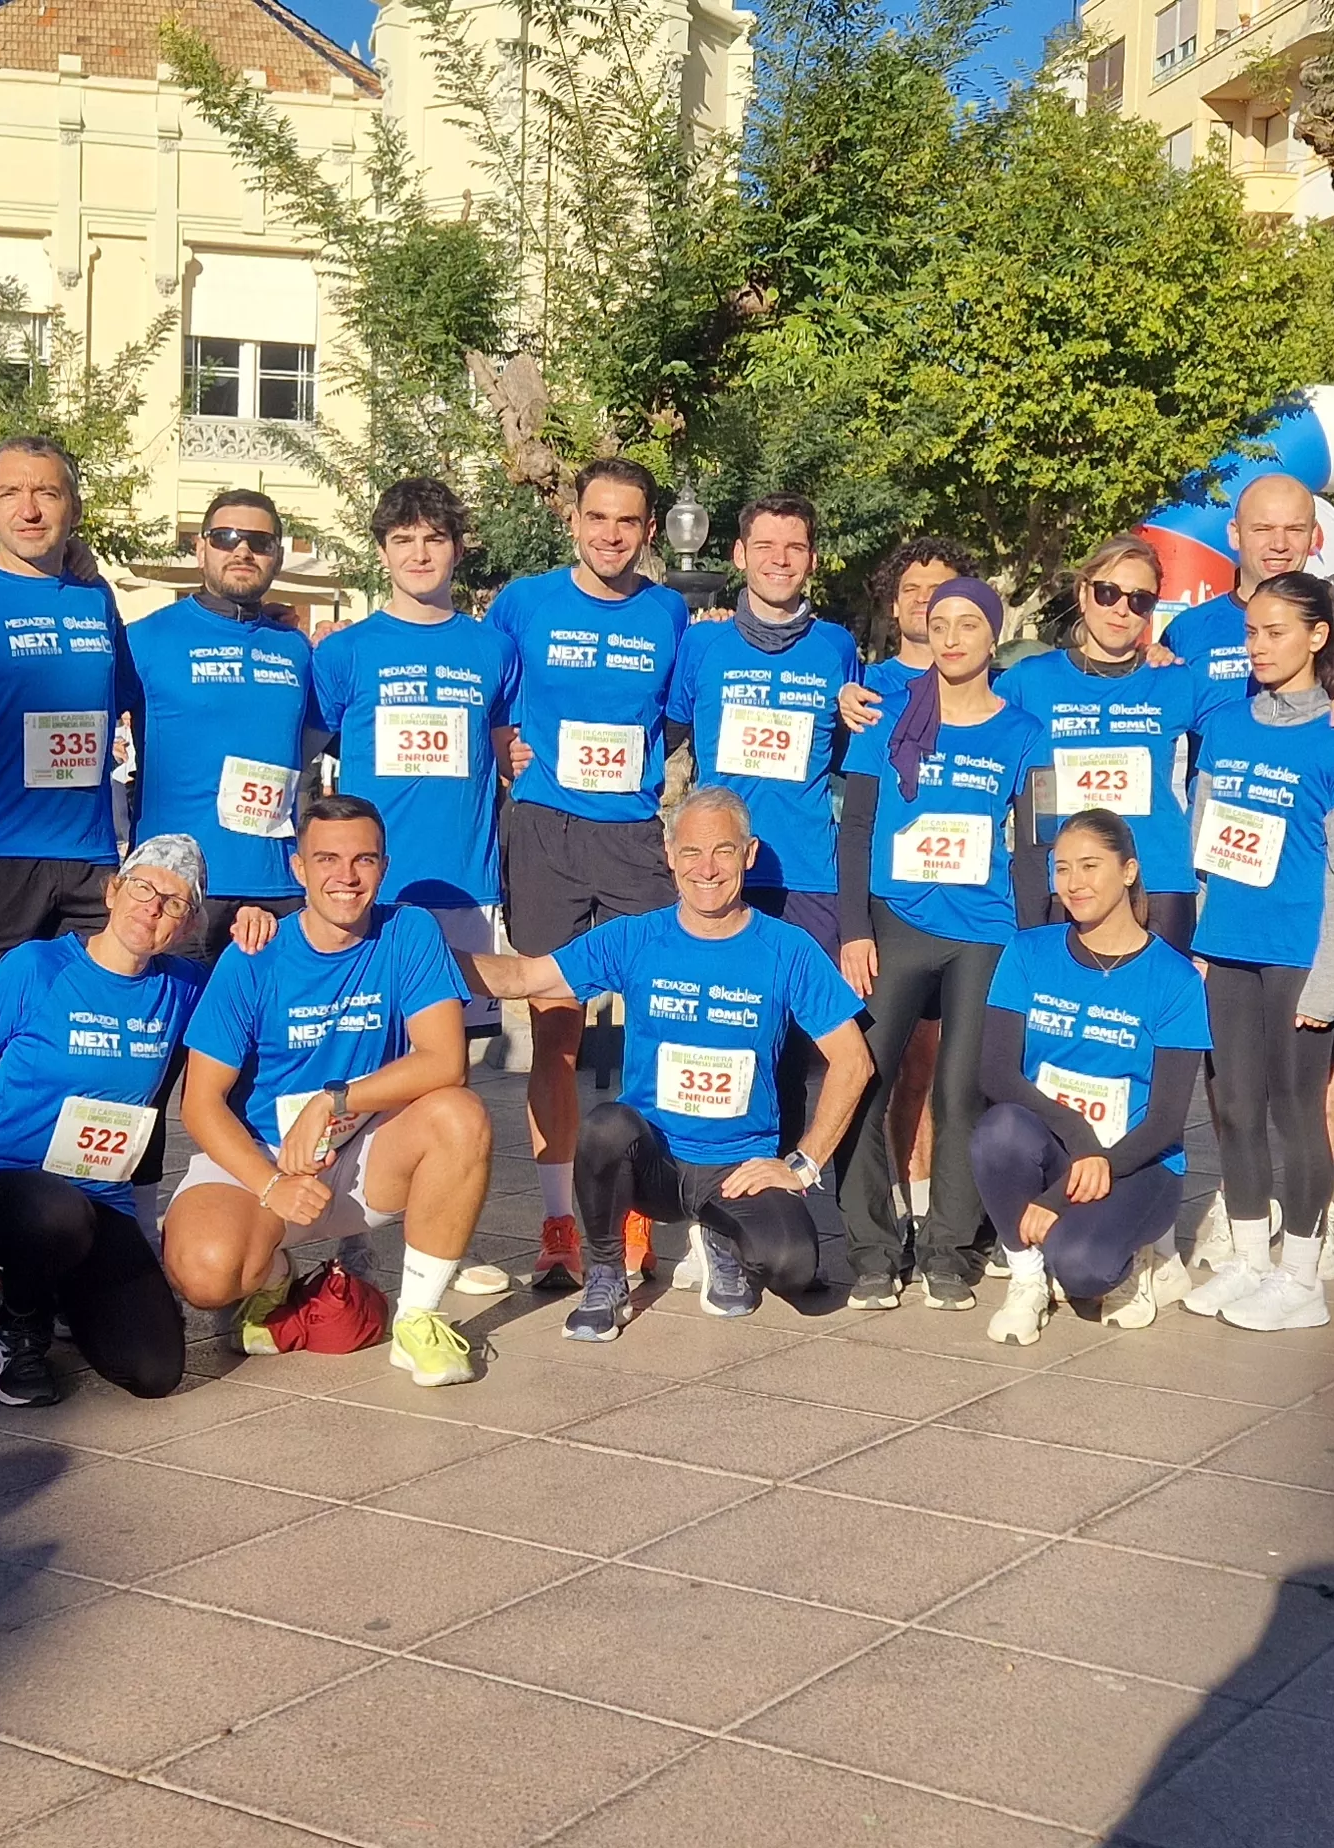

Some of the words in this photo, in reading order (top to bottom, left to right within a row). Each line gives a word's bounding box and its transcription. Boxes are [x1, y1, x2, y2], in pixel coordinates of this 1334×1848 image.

[5, 617, 55, 629] MEDIAZION
[9, 633, 59, 649] NEXT
[69, 638, 102, 648] HOME
[551, 630, 599, 643] MEDIAZION
[619, 634, 656, 652] kablex
[189, 646, 243, 658] MEDIAZION
[548, 644, 597, 661] NEXT
[607, 653, 639, 665] HOME
[191, 662, 242, 677] NEXT
[254, 669, 286, 679] HOME
[379, 664, 427, 677] MEDIAZION
[447, 667, 482, 684] kablex
[724, 670, 772, 680] MEDIAZION
[792, 671, 827, 688] kablex
[380, 681, 428, 697] NEXT
[436, 687, 469, 698] HOME
[722, 684, 770, 698] NEXT
[779, 692, 812, 702] HOME
[1052, 703, 1101, 714] MEDIAZION
[1121, 702, 1162, 715] kablex
[1052, 717, 1100, 732] NEXT
[1110, 720, 1146, 731] HOME
[50, 732, 97, 755] 335
[399, 730, 448, 750] 330
[742, 726, 791, 750] 529
[397, 753, 450, 762] ENRIQUE
[579, 746, 626, 767] 334
[743, 748, 786, 761] LORIEN
[51, 757, 97, 767] ANDRES
[405, 763, 422, 772] 8K
[745, 758, 761, 769] 8K
[967, 755, 1005, 774] kablex
[56, 769, 74, 780] 8K
[952, 772, 987, 787] HOME
[1077, 770, 1128, 790] 423
[1265, 762, 1301, 785] kablex
[582, 777, 598, 788] 8K
[241, 782, 285, 809] 531
[1084, 792, 1122, 801] HELEN
[236, 804, 281, 820] CRISTIAN
[242, 816, 259, 828] 8K
[1219, 825, 1261, 854] 422
[917, 837, 966, 858] 421
[1210, 845, 1262, 868] HADASSAH
[923, 860, 961, 870] RIHAB
[1217, 858, 1232, 870] 8K
[922, 869, 938, 880] 8K
[652, 978, 700, 995] MEDIAZION
[722, 985, 762, 1004] kablex
[1033, 992, 1080, 1011] MEDIAZION
[650, 994, 699, 1013] NEXT
[69, 1011, 119, 1026] MEDIAZION
[708, 1007, 743, 1021] HOME
[1029, 1008, 1076, 1029] NEXT
[1099, 1006, 1140, 1026] kablex
[70, 1030, 121, 1049] NEXT
[1084, 1025, 1119, 1040] HOME
[693, 1054, 733, 1062] CARRERA
[680, 1069, 732, 1093] 332
[678, 1091, 732, 1104] ENRIQUE
[684, 1102, 700, 1113] 8K
[77, 1126, 128, 1154] 522
[83, 1154, 113, 1166] MARI
[75, 1164, 93, 1175] 8K
